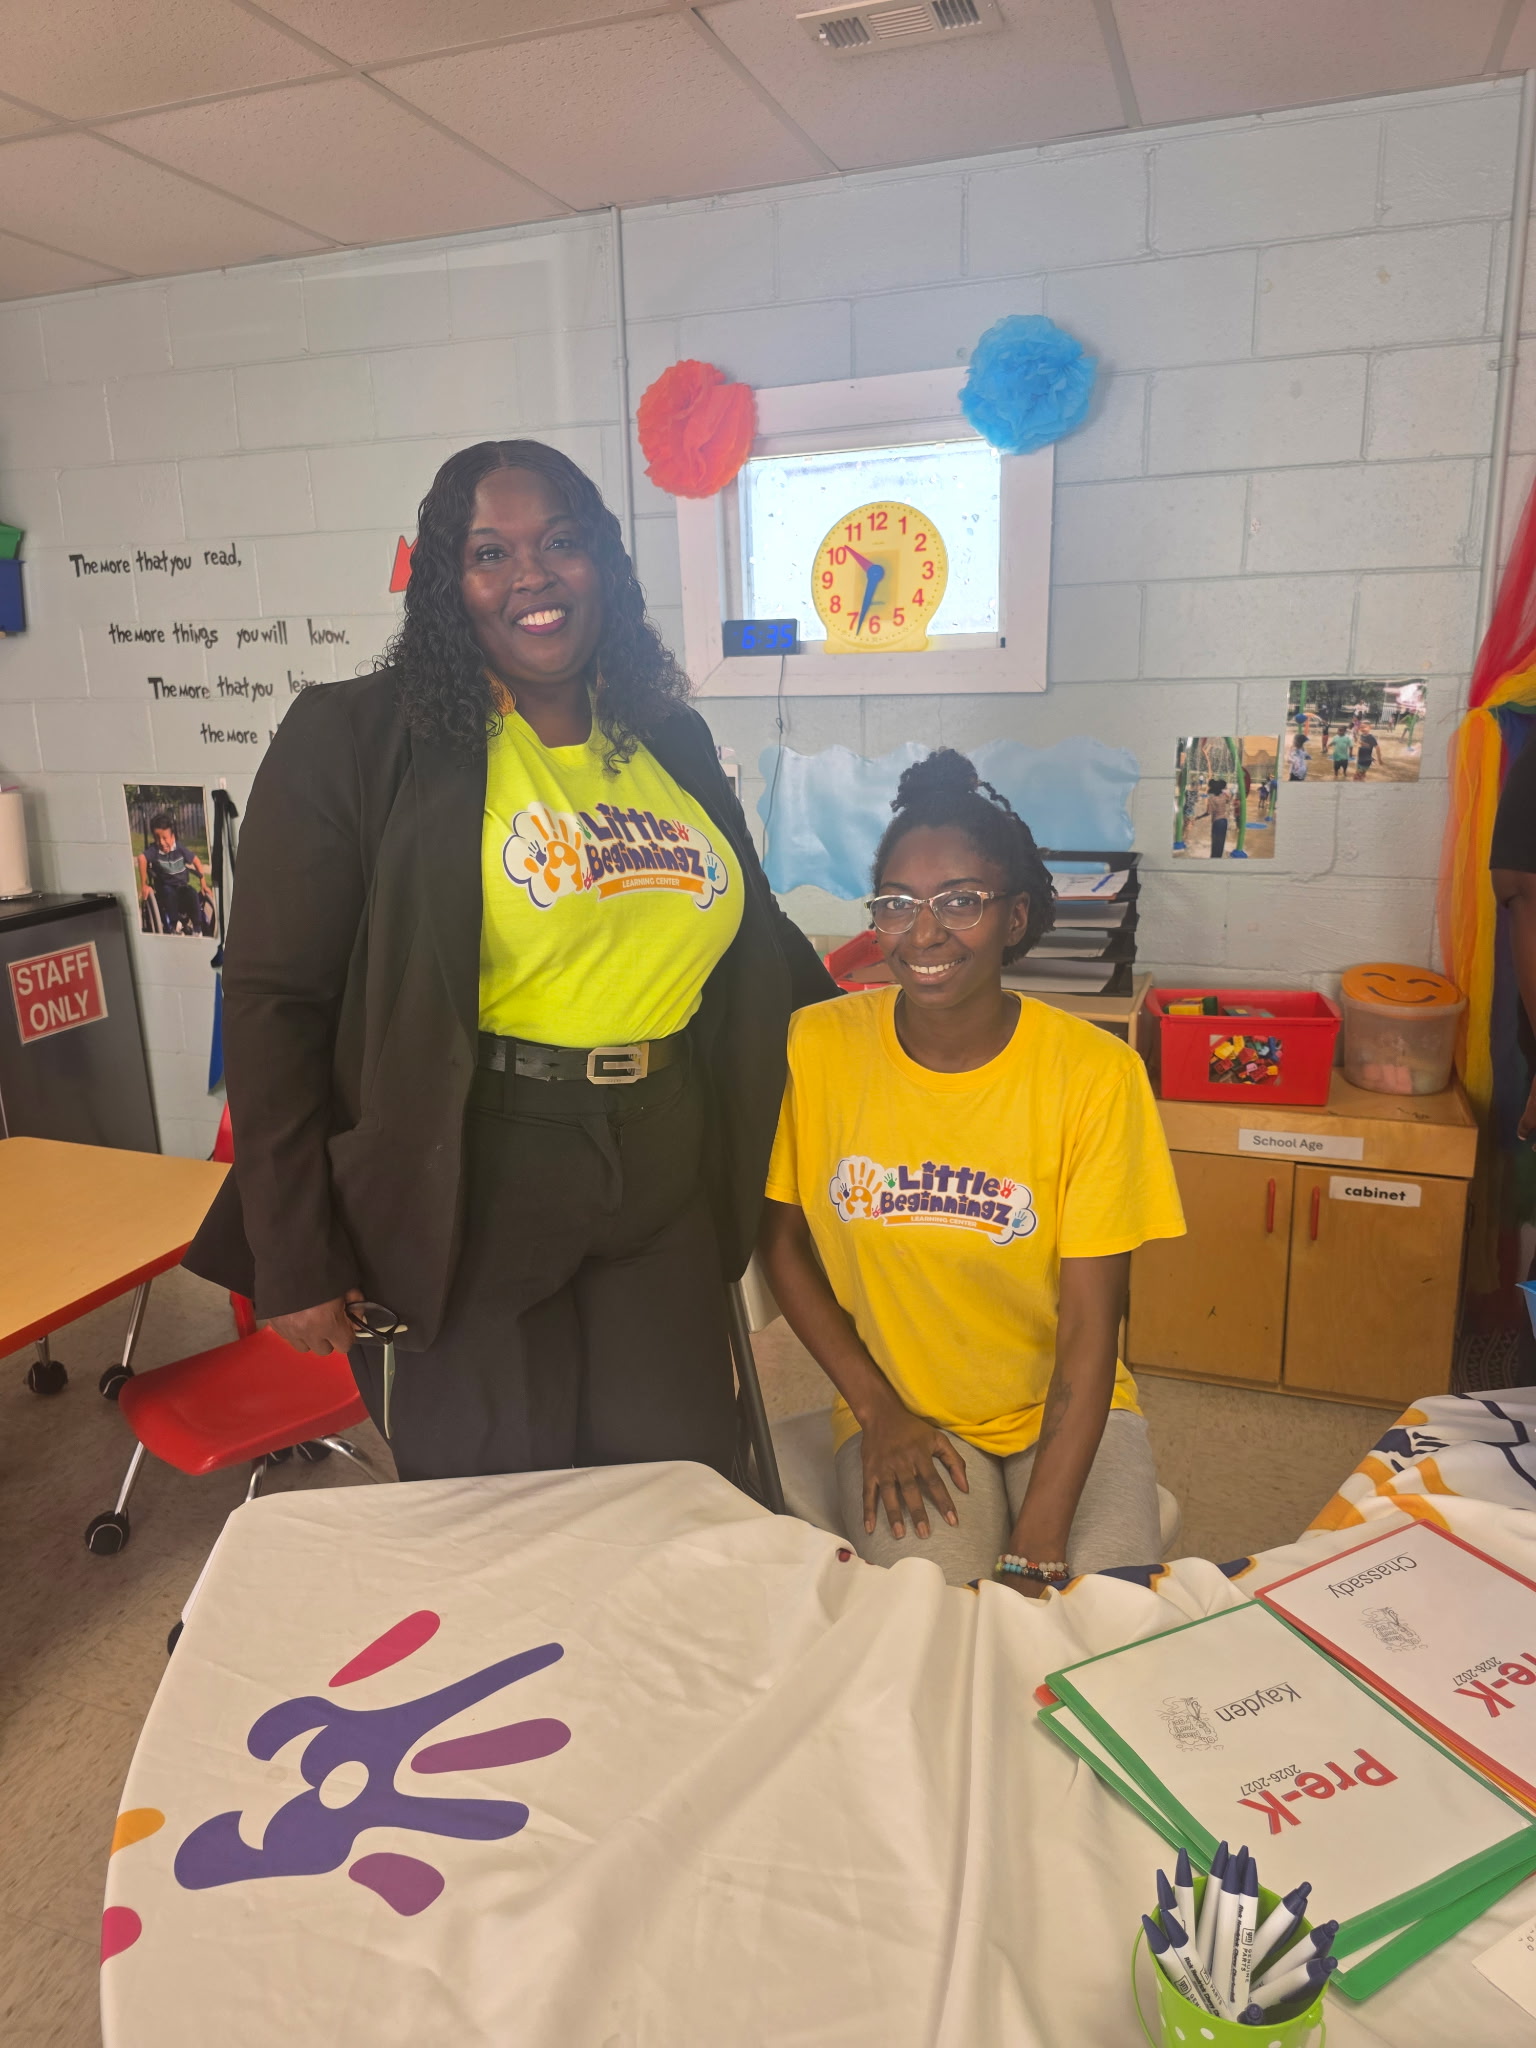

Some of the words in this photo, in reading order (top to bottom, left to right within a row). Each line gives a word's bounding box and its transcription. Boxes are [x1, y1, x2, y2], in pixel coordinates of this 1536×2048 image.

[867, 511, 888, 531] 12
[898, 516, 907, 535] 1
[844, 522, 862, 542] 11
[914, 532, 927, 552] 2
[69, 553, 98, 578] The
[135, 550, 168, 573] that
[170, 555, 192, 577] you
[203, 542, 242, 567] read,
[826, 546, 847, 566] 10
[922, 560, 934, 580] 3
[822, 571, 834, 590] 9
[829, 595, 841, 614] 8
[911, 588, 925, 607] 4
[847, 611, 859, 631] 7
[869, 615, 881, 635] 6
[892, 607, 905, 627] 5
[108, 622, 133, 645] the
[173, 622, 218, 649] things
[237, 628, 258, 649] you
[261, 620, 288, 645] will
[741, 624, 793, 649] 6:35
[148, 677, 177, 700] The
[217, 675, 249, 699] that
[251, 683, 274, 703] you
[200, 723, 225, 745] the
[579, 803, 680, 842] Little
[622, 878, 655, 888] LEARNING
[656, 877, 680, 887] CENTER
[16, 951, 89, 996] STAFF
[29, 989, 89, 1031] ONLY
[1253, 1135, 1297, 1148] School
[1299, 1139, 1324, 1151] Age
[898, 1161, 1000, 1197] Little
[1345, 1186, 1406, 1201] cabinet
[911, 1215, 948, 1224] LEARNING
[949, 1218, 978, 1228] CENTER
[1328, 1556, 1417, 1599] Chassady
[1453, 1656, 1501, 1686] 2026-2027
[1215, 1683, 1302, 1722] Kayden
[1240, 1764, 1301, 1796] 2026-2027
[1236, 1748, 1399, 1835] Pre-K
